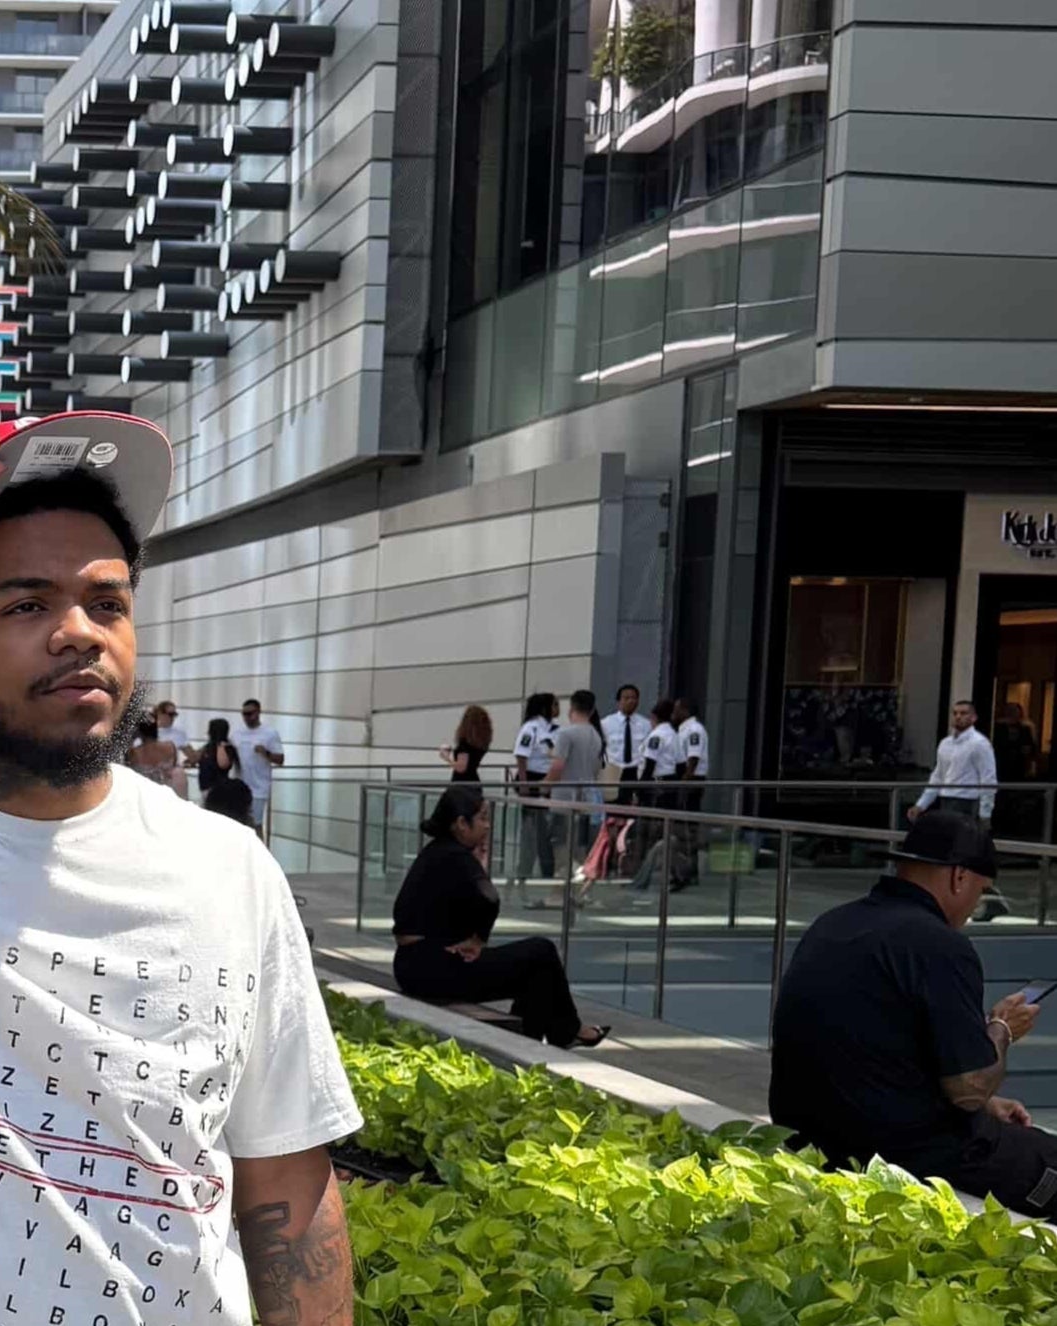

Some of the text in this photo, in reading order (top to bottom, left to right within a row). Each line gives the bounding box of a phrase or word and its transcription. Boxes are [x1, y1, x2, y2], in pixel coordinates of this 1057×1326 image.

[6, 947, 19, 965] S
[51, 952, 64, 971] P
[94, 957, 105, 976] E
[137, 961, 149, 980] E
[179, 964, 192, 983] D
[218, 968, 227, 987] E
[247, 974, 255, 993] D
[12, 995, 26, 1013] T
[89, 995, 102, 1015] E
[133, 998, 146, 1018] E
[178, 1003, 189, 1022] S
[215, 1006, 227, 1025] N
[8, 1030, 20, 1048] T
[48, 1043, 62, 1063] C
[94, 1051, 108, 1071] T
[136, 1061, 150, 1080] C
[178, 1069, 189, 1088] E
[1, 1066, 15, 1086] Z
[45, 1076, 59, 1095] E
[87, 1090, 101, 1105] T
[132, 1100, 144, 1118] T
[169, 1107, 183, 1125] B
[40, 1113, 54, 1132] Z
[86, 1121, 99, 1140] E
[194, 1150, 208, 1166] E
[35, 1149, 50, 1168] T
[80, 1157, 95, 1177] H
[126, 1166, 138, 1187] E
[163, 1179, 178, 1196] D
[33, 1184, 45, 1203] T
[74, 1197, 87, 1216] A
[118, 1205, 131, 1224] G
[157, 1214, 170, 1231] C
[27, 1220, 38, 1239] V
[66, 1235, 81, 1253] A
[111, 1242, 121, 1261] A
[148, 1251, 163, 1266] G
[6, 1294, 17, 1313] L
[49, 1306, 65, 1325] B
[60, 1269, 70, 1288] L
[103, 1280, 118, 1297] B
[142, 1286, 155, 1303] O
[175, 1289, 190, 1307] X
[210, 1297, 222, 1313] A
